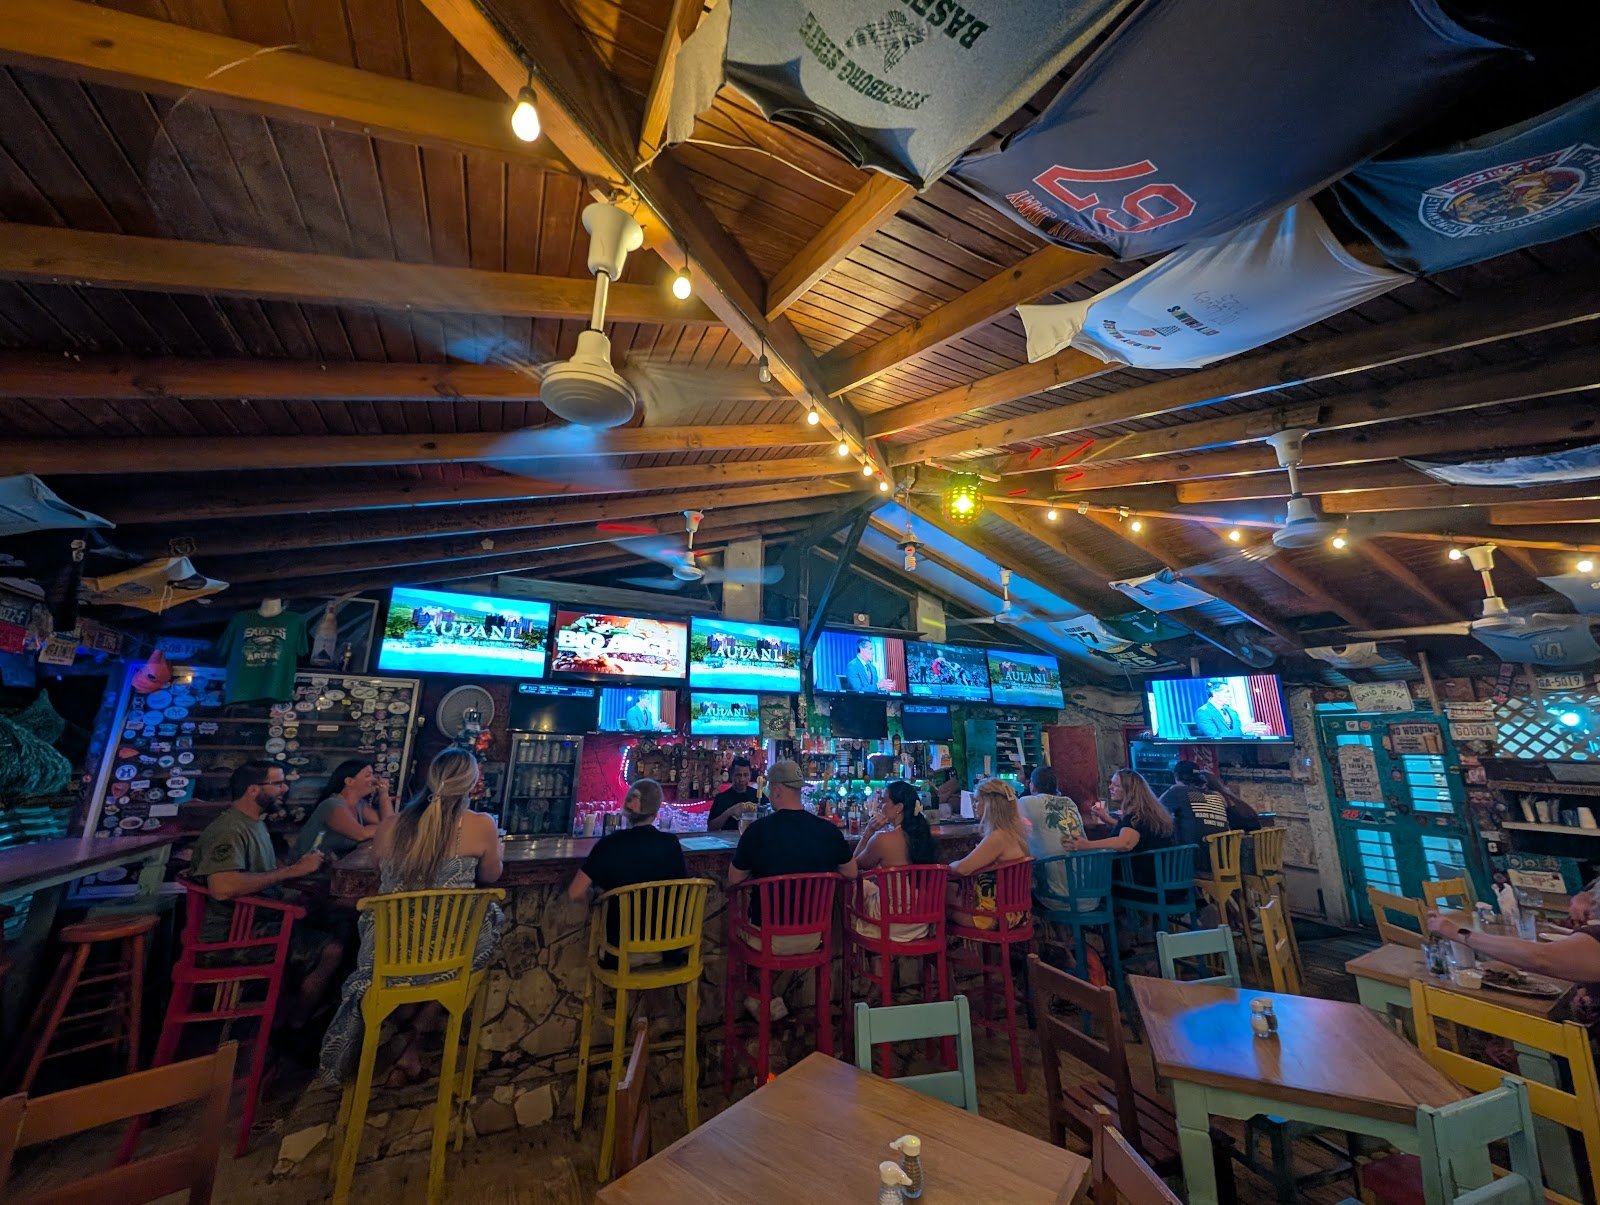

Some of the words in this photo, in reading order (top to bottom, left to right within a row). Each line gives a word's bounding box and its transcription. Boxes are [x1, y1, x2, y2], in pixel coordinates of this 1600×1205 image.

[1004, 670, 1047, 684] AULANI
[1357, 689, 1378, 702] DAVID
[1380, 688, 1406, 699] ORTIZ
